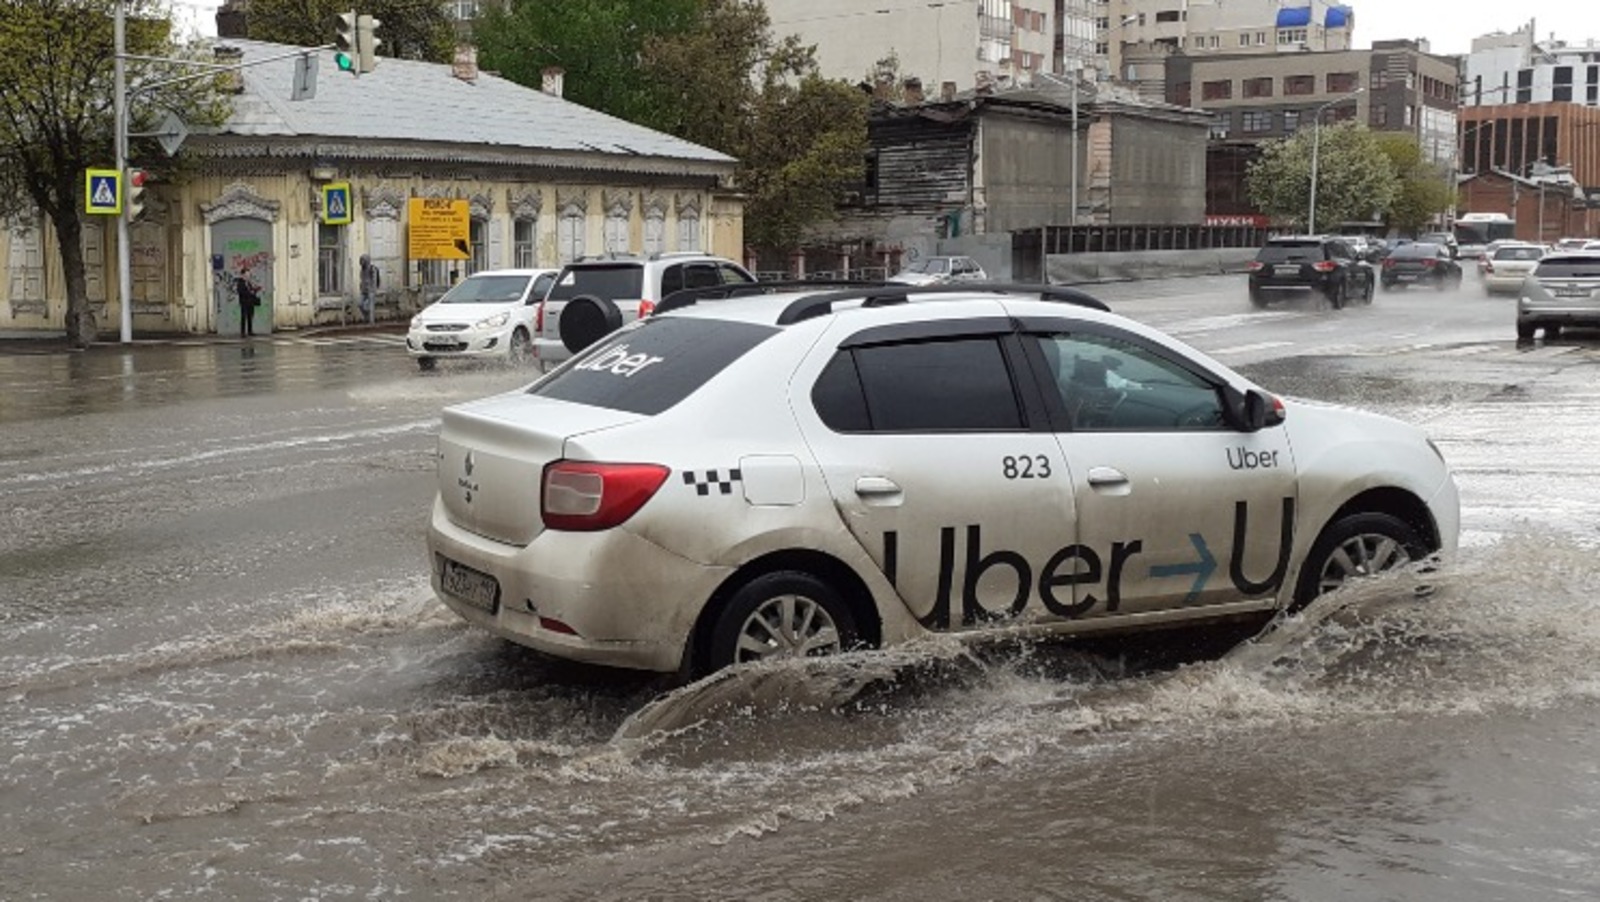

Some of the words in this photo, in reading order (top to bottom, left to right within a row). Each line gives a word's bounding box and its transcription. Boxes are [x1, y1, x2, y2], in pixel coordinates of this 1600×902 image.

[574, 343, 664, 378] Uber
[1001, 454, 1053, 480] 823
[1225, 447, 1280, 470] Uber
[882, 524, 1142, 629] Uber
[1229, 497, 1295, 595] U
